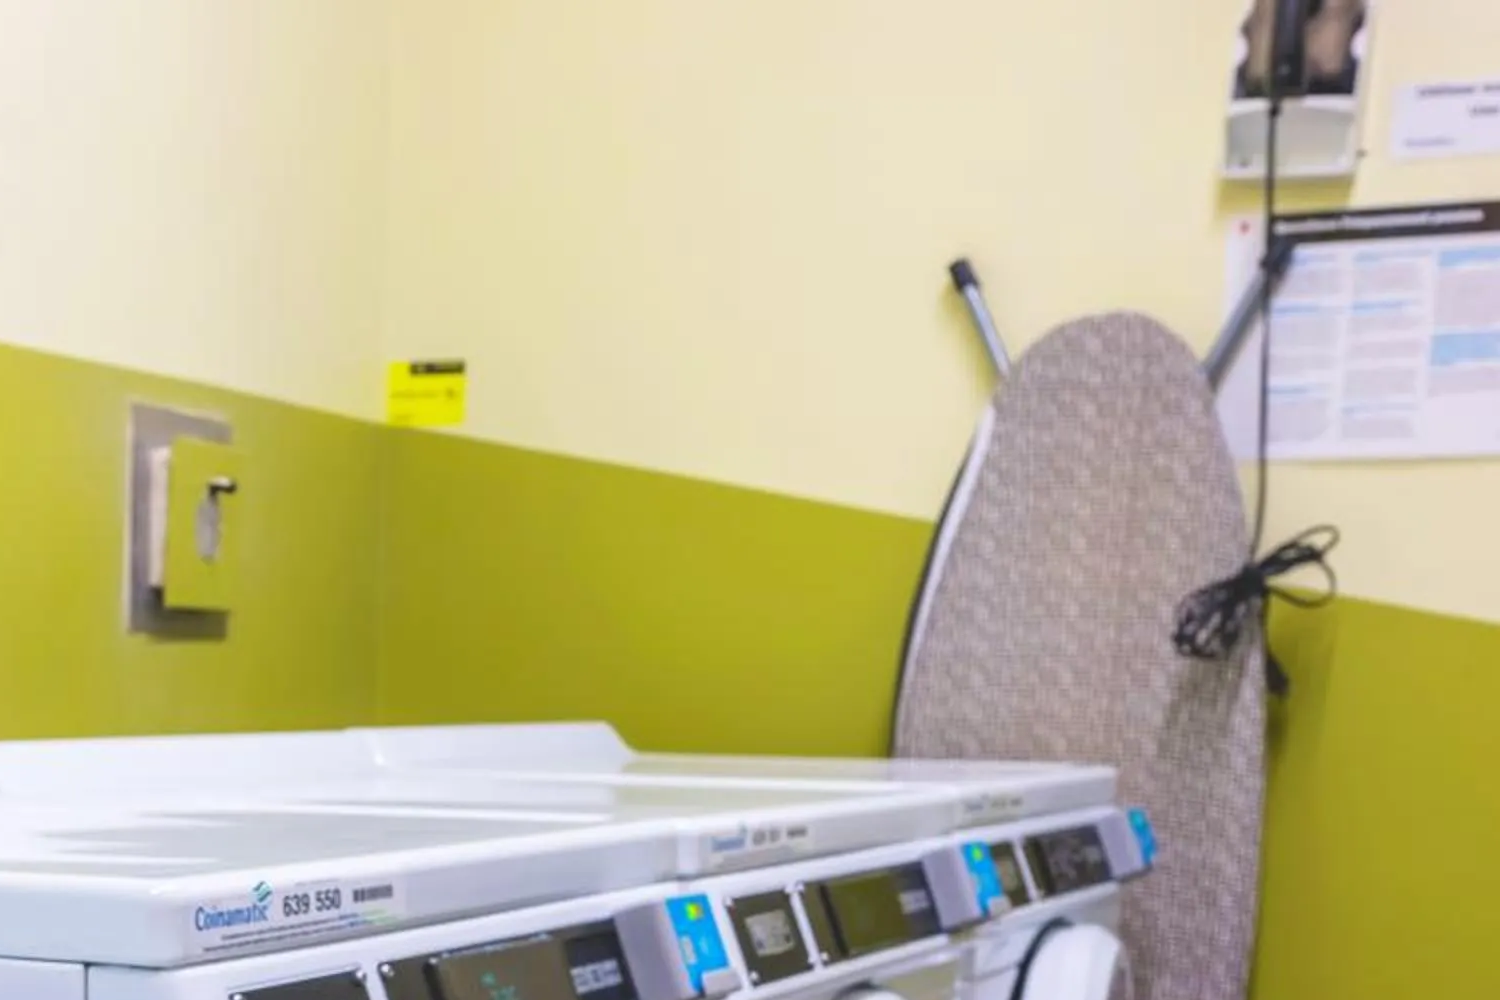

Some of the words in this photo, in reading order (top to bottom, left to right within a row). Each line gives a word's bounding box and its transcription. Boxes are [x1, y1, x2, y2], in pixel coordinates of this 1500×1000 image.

[195, 902, 269, 931] Coinamatic
[283, 894, 310, 917] 639
[316, 888, 342, 912] 550
